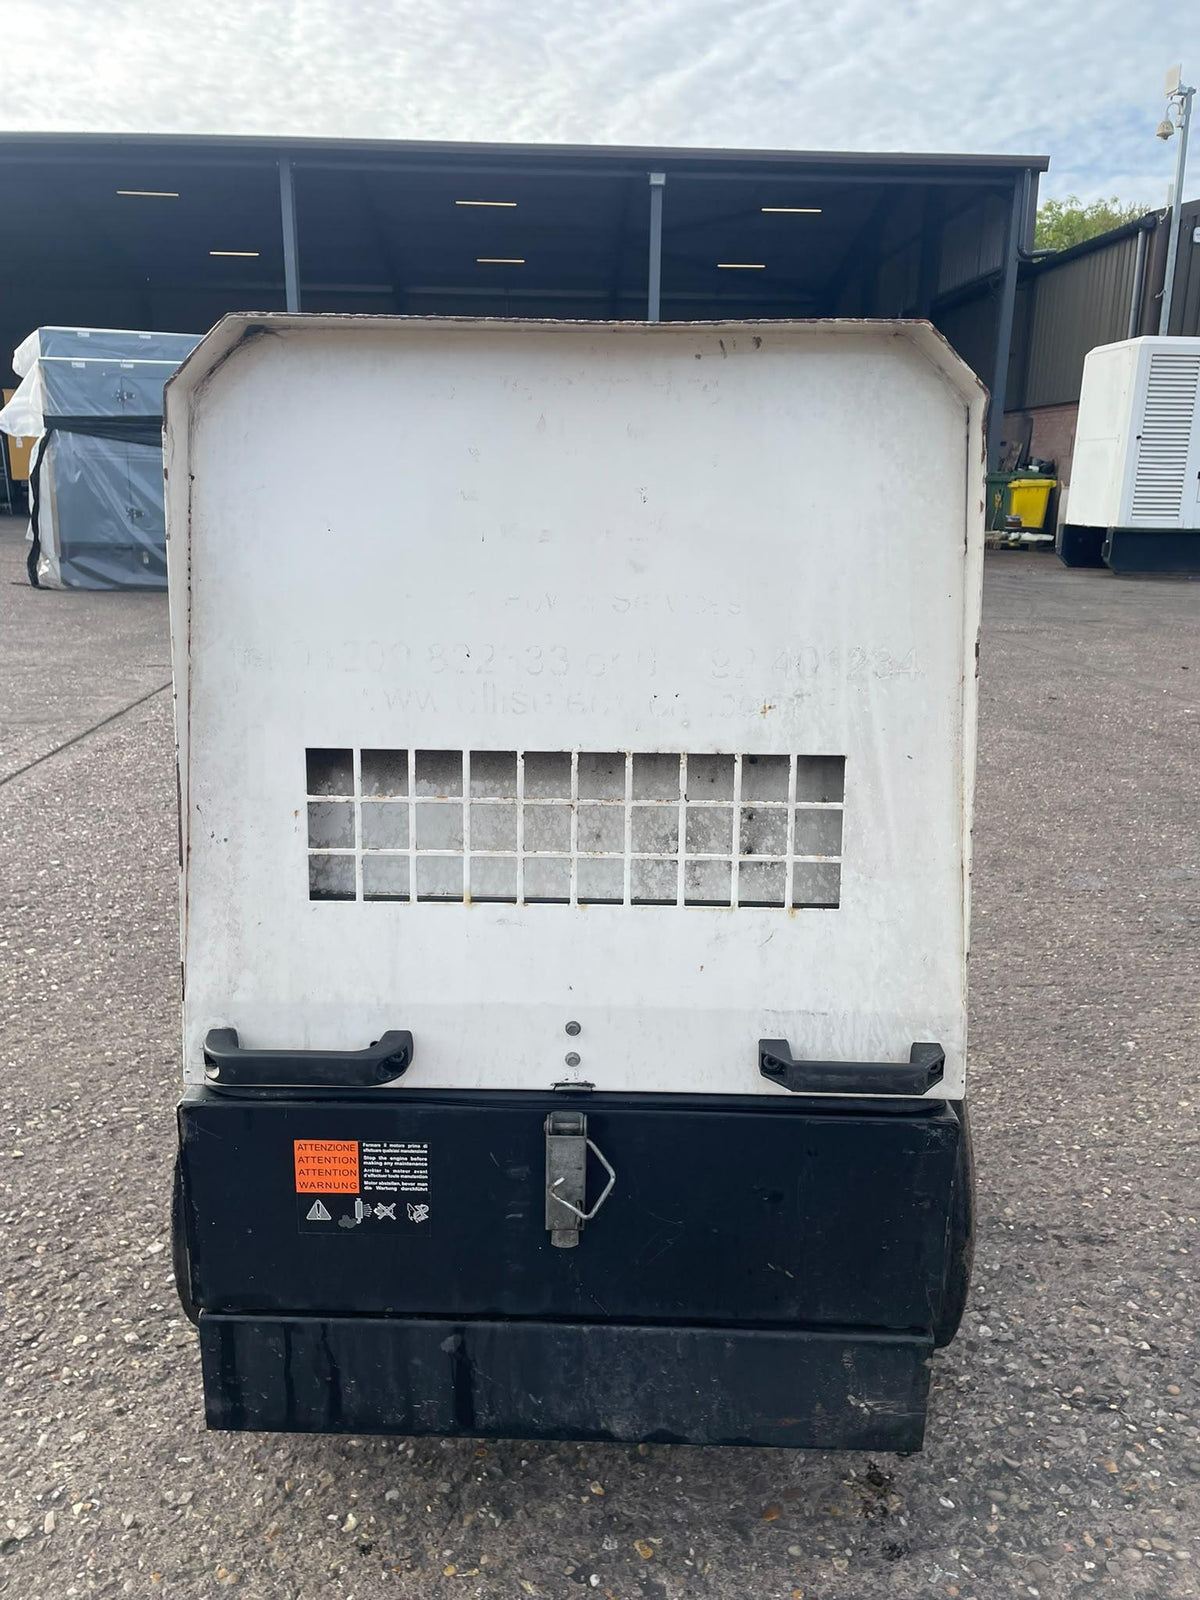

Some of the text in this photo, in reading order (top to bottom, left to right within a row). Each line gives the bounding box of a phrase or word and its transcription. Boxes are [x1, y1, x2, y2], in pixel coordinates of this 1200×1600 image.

[297, 1143, 356, 1152] ATTENZIONE
[298, 1156, 357, 1165] ATTENTION
[298, 1168, 357, 1177] ATTENTION
[299, 1181, 358, 1190] WARNUNG
